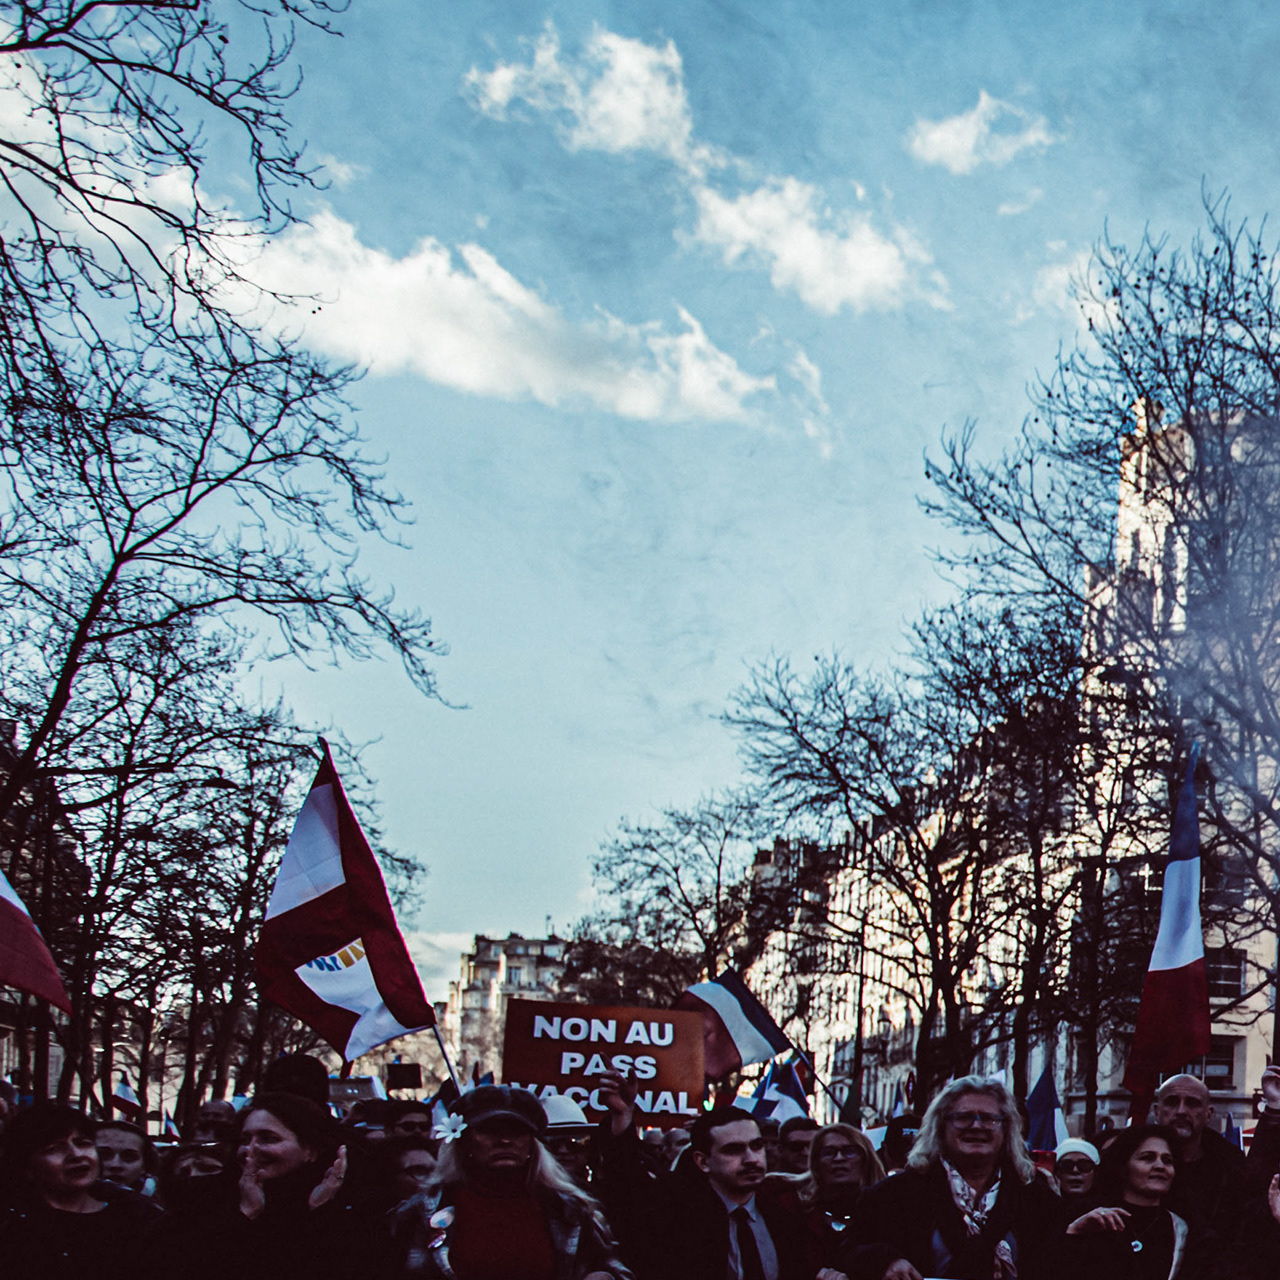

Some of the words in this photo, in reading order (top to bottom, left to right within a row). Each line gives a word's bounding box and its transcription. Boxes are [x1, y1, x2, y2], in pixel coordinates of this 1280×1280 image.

[533, 1015, 617, 1043] NON
[624, 1020, 674, 1046] AU
[560, 1051, 657, 1080] PASS
